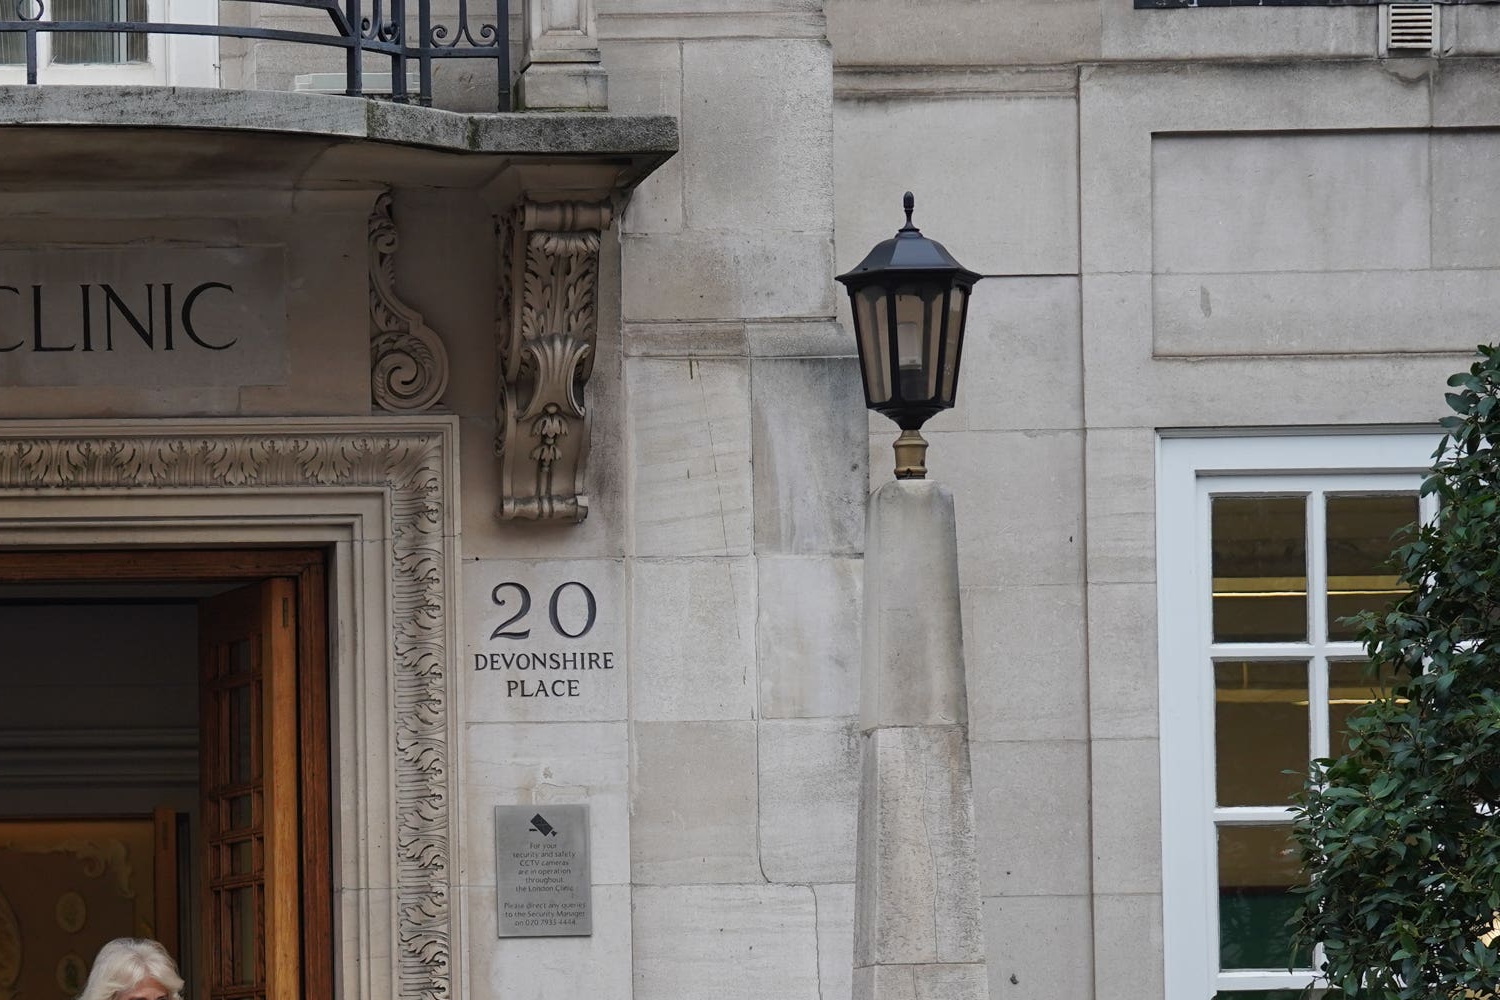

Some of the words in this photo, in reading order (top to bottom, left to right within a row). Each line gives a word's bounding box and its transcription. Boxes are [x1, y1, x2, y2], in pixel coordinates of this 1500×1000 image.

[490, 581, 597, 641] 20
[474, 652, 614, 671] DEVONSHIRE
[506, 680, 581, 698] PLACE
